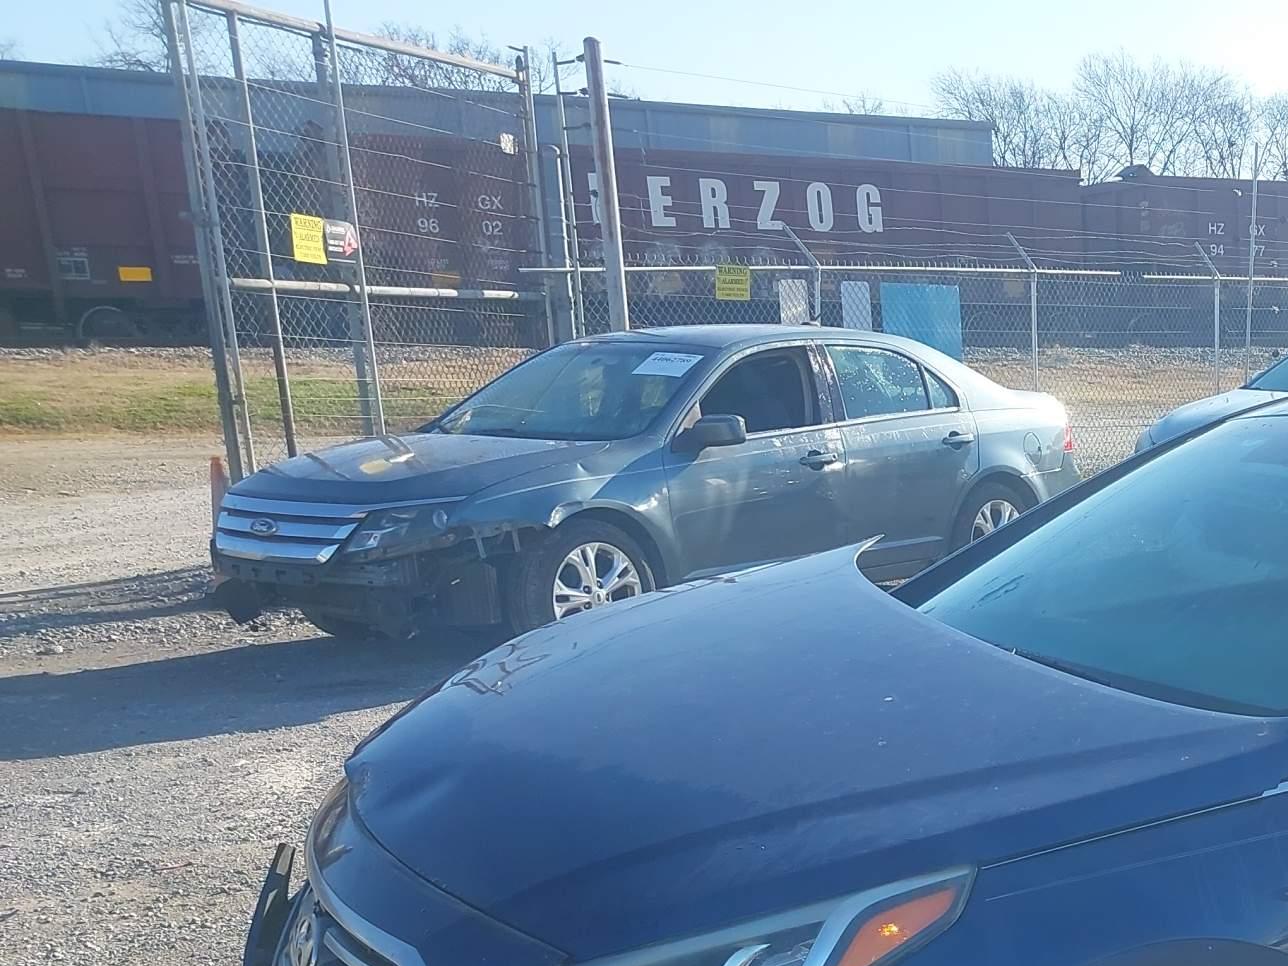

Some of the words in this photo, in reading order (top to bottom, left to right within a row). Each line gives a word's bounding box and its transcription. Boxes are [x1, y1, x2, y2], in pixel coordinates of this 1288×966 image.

[415, 192, 440, 208] HZ
[478, 194, 504, 210] GX
[417, 217, 440, 233] 96
[482, 220, 504, 236] 02
[1208, 222, 1225, 235] HZ
[1209, 244, 1225, 256] 94
